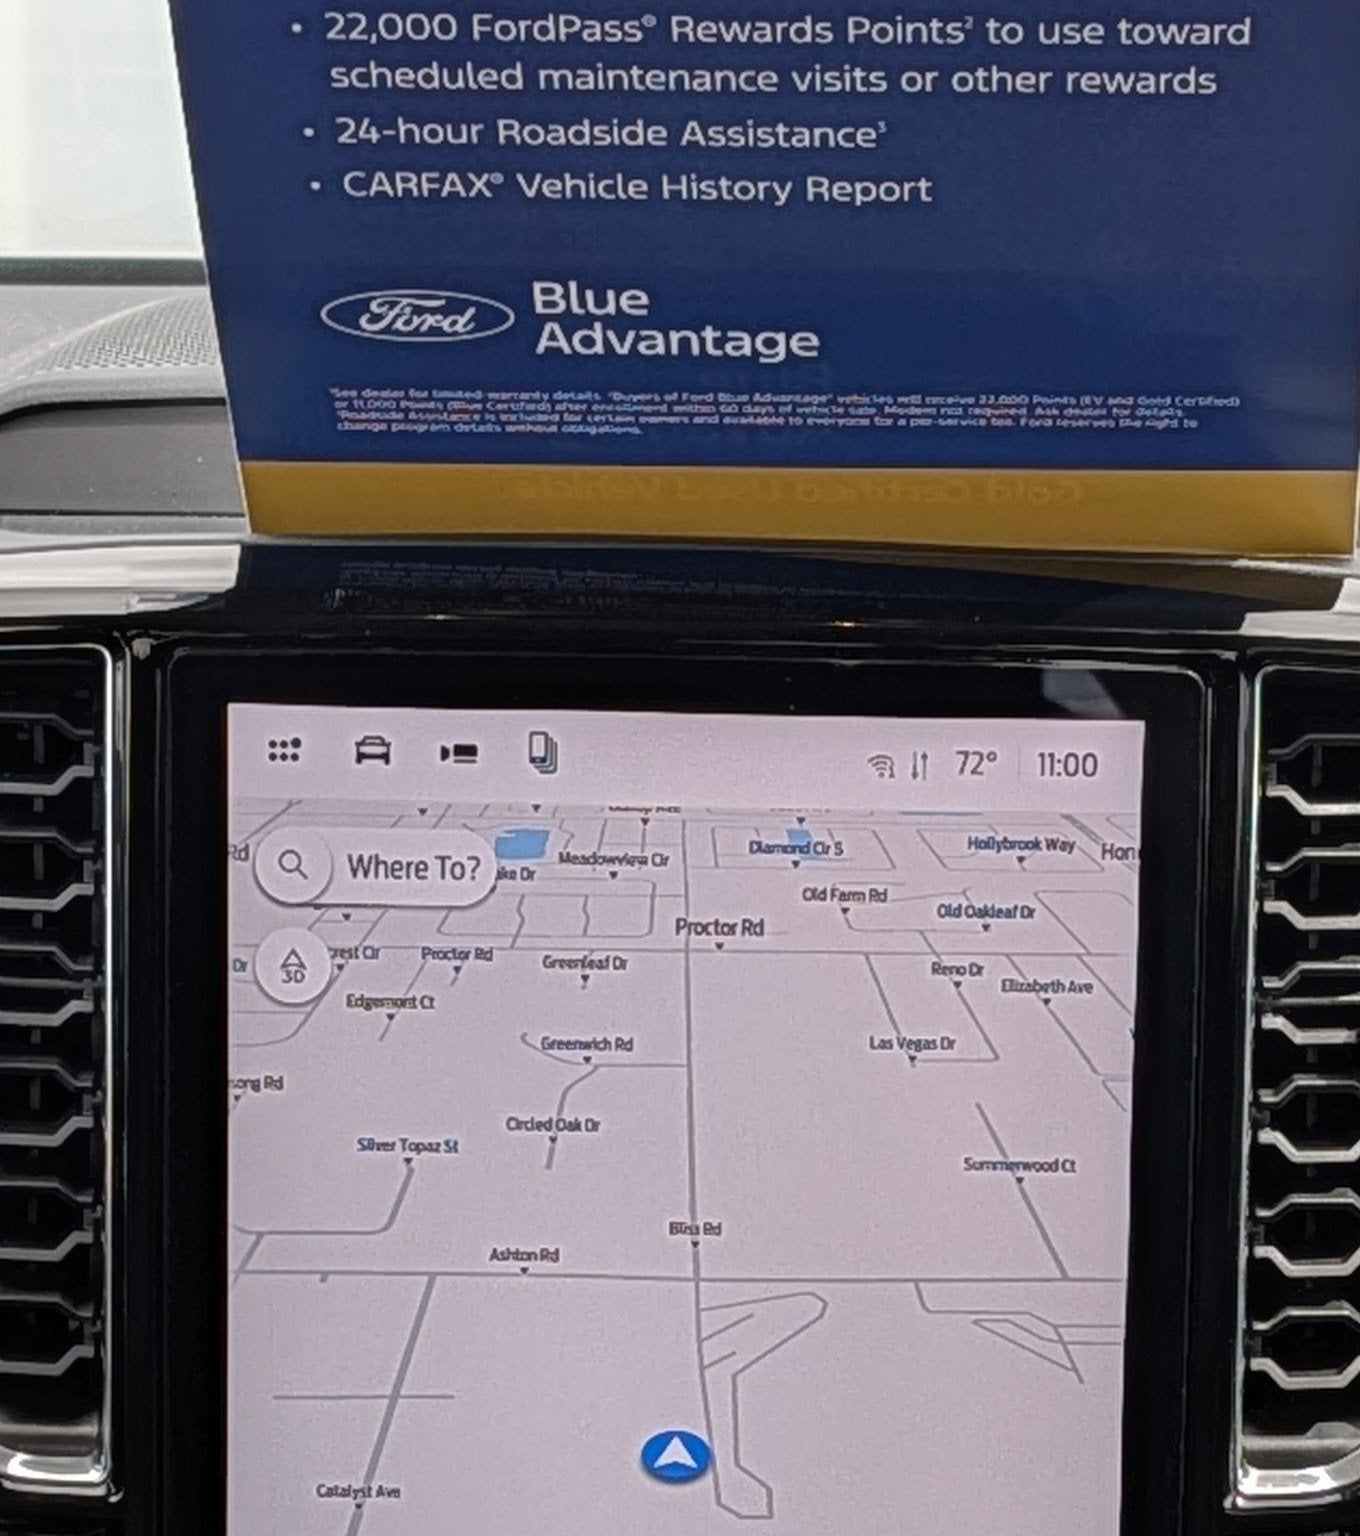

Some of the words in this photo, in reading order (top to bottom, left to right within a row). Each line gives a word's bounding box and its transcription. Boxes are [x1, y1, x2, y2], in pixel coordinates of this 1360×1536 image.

[324, 12, 458, 44] 22,000
[671, 14, 834, 45] Rewards
[986, 18, 1024, 46] to
[1039, 20, 1105, 46] use
[1117, 16, 1253, 47] toward
[330, 61, 524, 91] scheduled
[538, 63, 779, 93] maintenance
[791, 64, 888, 93] visits
[900, 71, 939, 93] or
[950, 65, 1053, 94] other
[1065, 66, 1218, 95] rewards
[336, 117, 485, 145] 24-hour
[496, 119, 669, 147] Roadside
[516, 172, 649, 200] Vehicle
[661, 174, 793, 207] History
[806, 176, 934, 207] Report
[531, 279, 651, 317] Blue
[358, 296, 478, 335] Ford
[534, 321, 821, 364] Advantage
[955, 750, 998, 776] 72°
[1038, 751, 1100, 778] 11:00
[748, 840, 811, 856] Diamond
[834, 841, 844, 856] S
[967, 836, 1043, 854] Hollybrook
[1044, 838, 1076, 855] Way
[347, 853, 429, 881] Where
[438, 855, 482, 882] To?
[558, 850, 649, 867] Meadowview
[519, 867, 536, 883] Dr
[802, 888, 828, 904] Old
[831, 889, 867, 905] Farm
[869, 889, 888, 905] Rd
[937, 904, 962, 919] Old
[964, 904, 1016, 920] Oakleaf
[1017, 905, 1036, 920] Dr
[675, 918, 738, 938] Proctor
[740, 918, 766, 938] Rd
[421, 946, 473, 961] Proctor
[475, 946, 494, 962] Rd
[542, 955, 610, 970] Greenleaf
[612, 956, 629, 971] Dr
[281, 967, 307, 985] 3D
[931, 963, 966, 978] Reno
[968, 963, 985, 978] Dr
[1001, 979, 1066, 994] Elizabeth
[1068, 980, 1094, 995] Ave
[346, 994, 417, 1013] Edgemont
[419, 995, 435, 1010] Ct
[541, 1036, 612, 1052] Greenwich
[614, 1037, 634, 1052] Rd
[869, 1036, 895, 1052] Las
[897, 1037, 938, 1055] Vegas
[939, 1037, 956, 1053] Dr
[263, 1075, 284, 1092] Rd
[505, 1116, 552, 1133] Circled
[554, 1117, 583, 1133] Oak
[584, 1117, 601, 1133] Dr
[356, 1138, 397, 1154] Silver
[399, 1139, 442, 1157] Topaz
[443, 1139, 460, 1155] St
[964, 1157, 1060, 1174] Summerwood
[1061, 1158, 1077, 1174] Ct
[703, 1221, 723, 1237] Rd
[489, 1247, 538, 1263] Ashton
[539, 1248, 560, 1264] Rd
[316, 1484, 372, 1502] Catalyst
[375, 1484, 401, 1500] Ave
